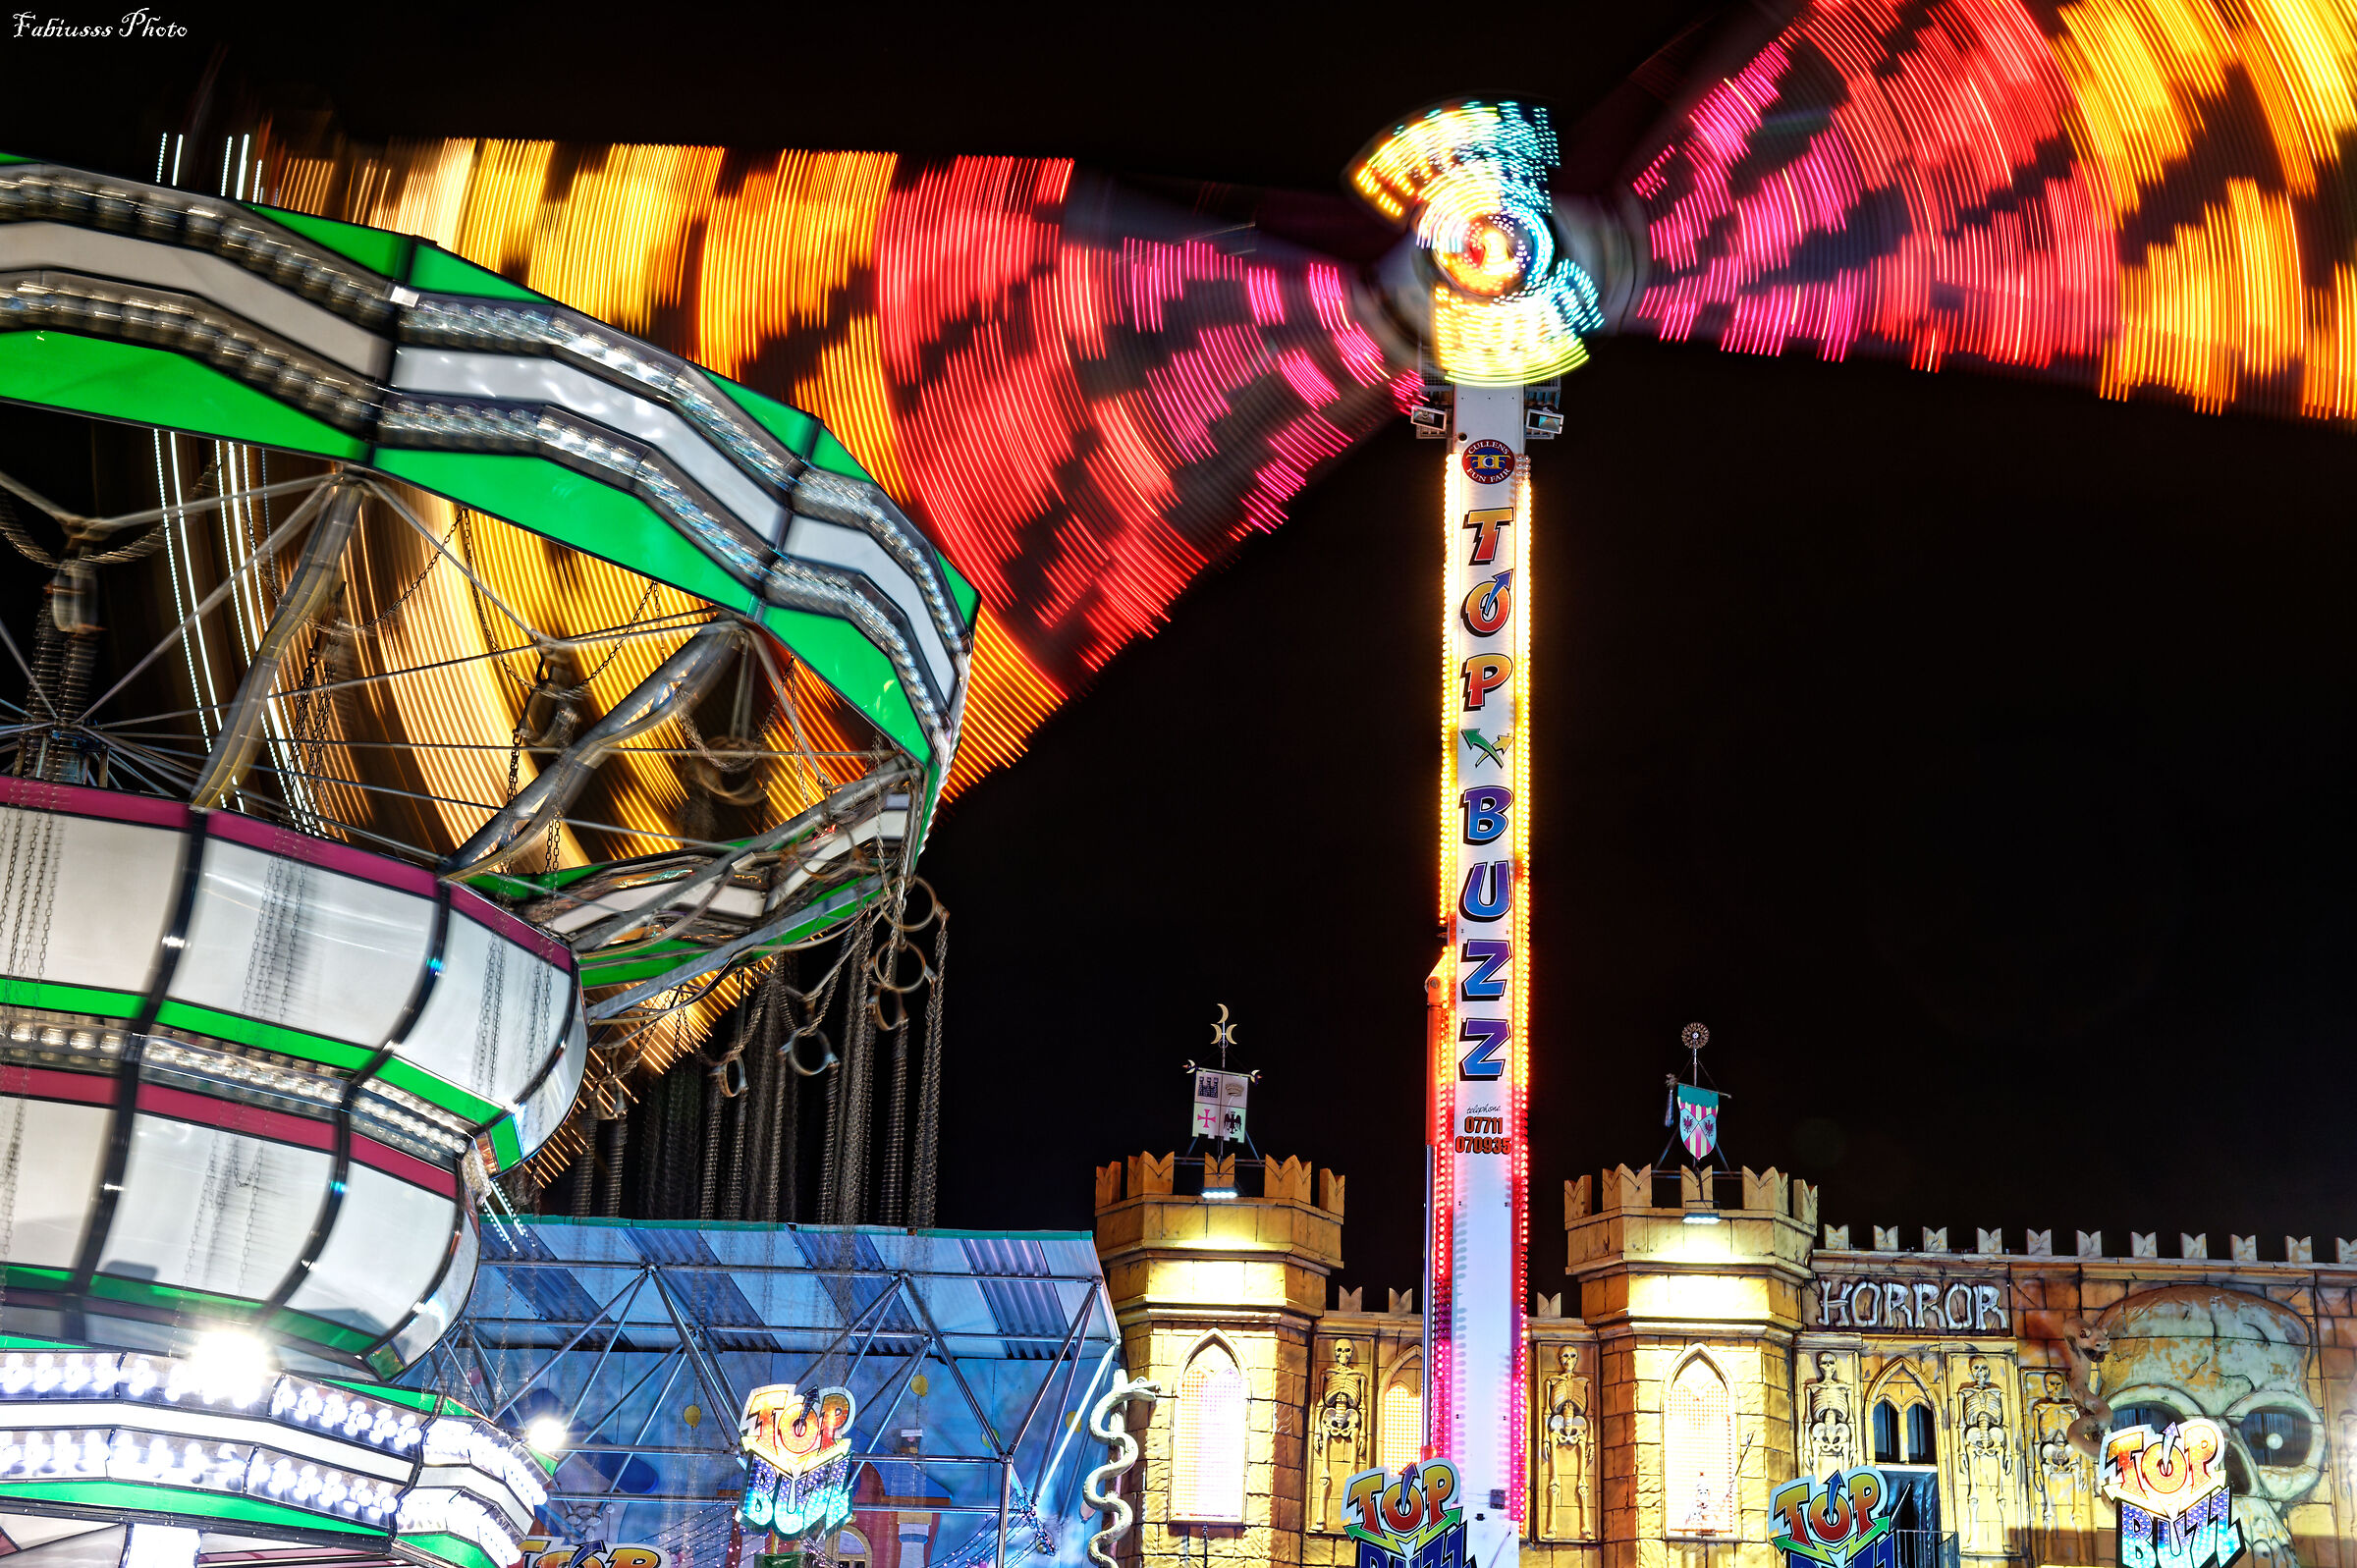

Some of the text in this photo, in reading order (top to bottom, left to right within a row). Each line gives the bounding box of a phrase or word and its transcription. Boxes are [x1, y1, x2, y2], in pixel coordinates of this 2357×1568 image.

[1466, 467, 1510, 482] FUN FAIR
[1468, 441, 1509, 455] CULLENS
[1460, 507, 1513, 712] TOP
[1458, 784, 1514, 1081] BUZZ
[1454, 1136, 1512, 1155] 070935
[1464, 1116, 1504, 1134] 07711
[1466, 1103, 1502, 1115] telephone
[1817, 1279, 2008, 1330] HORROR
[745, 1386, 850, 1457] TOP
[740, 1452, 853, 1541] BUZZ
[2104, 1423, 2220, 1500] TOP
[1345, 1463, 1455, 1541] TOP
[1773, 1470, 1881, 1551] TOP
[2115, 1486, 2247, 1568] BUZZ
